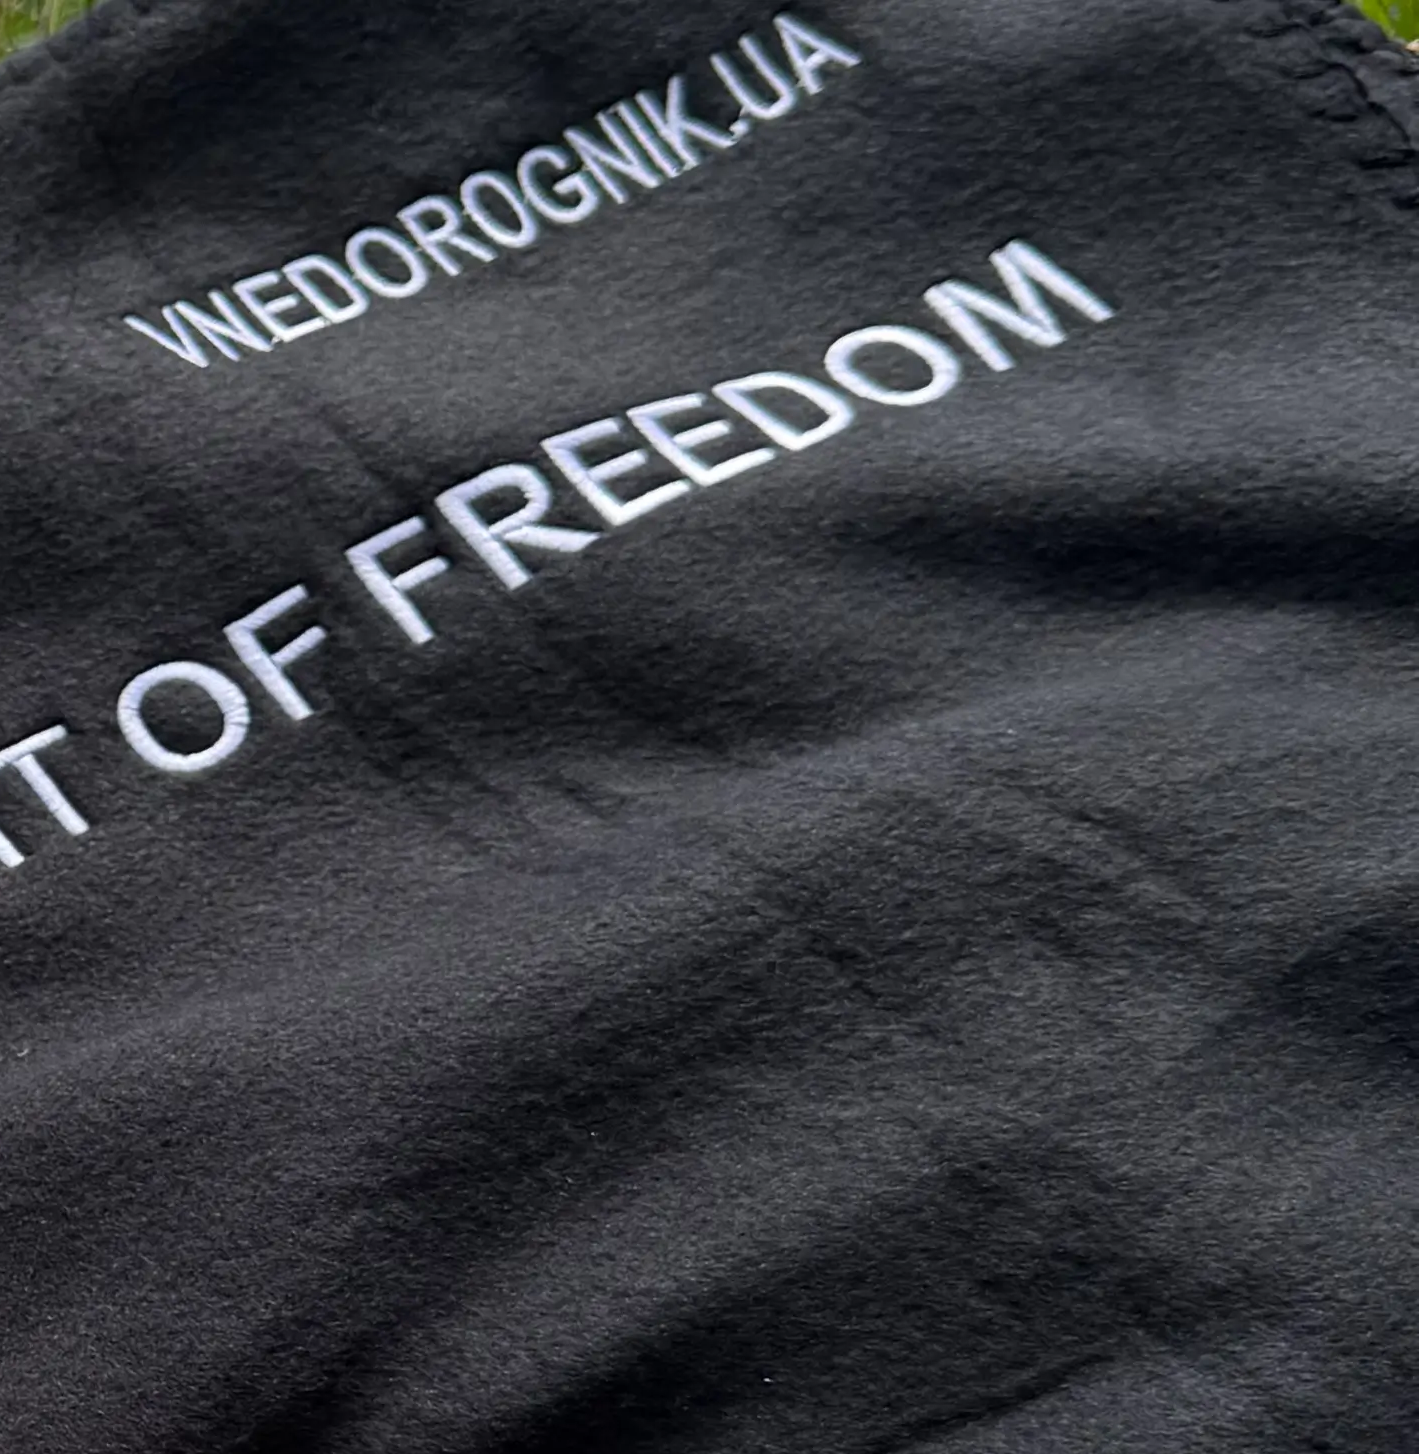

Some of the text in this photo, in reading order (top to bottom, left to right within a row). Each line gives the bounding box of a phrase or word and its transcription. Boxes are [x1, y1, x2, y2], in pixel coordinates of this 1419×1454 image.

[123, 15, 862, 370] VNEDOROGNIK.UA
[115, 584, 327, 774] OF
[345, 239, 1115, 645] FREEDOM
